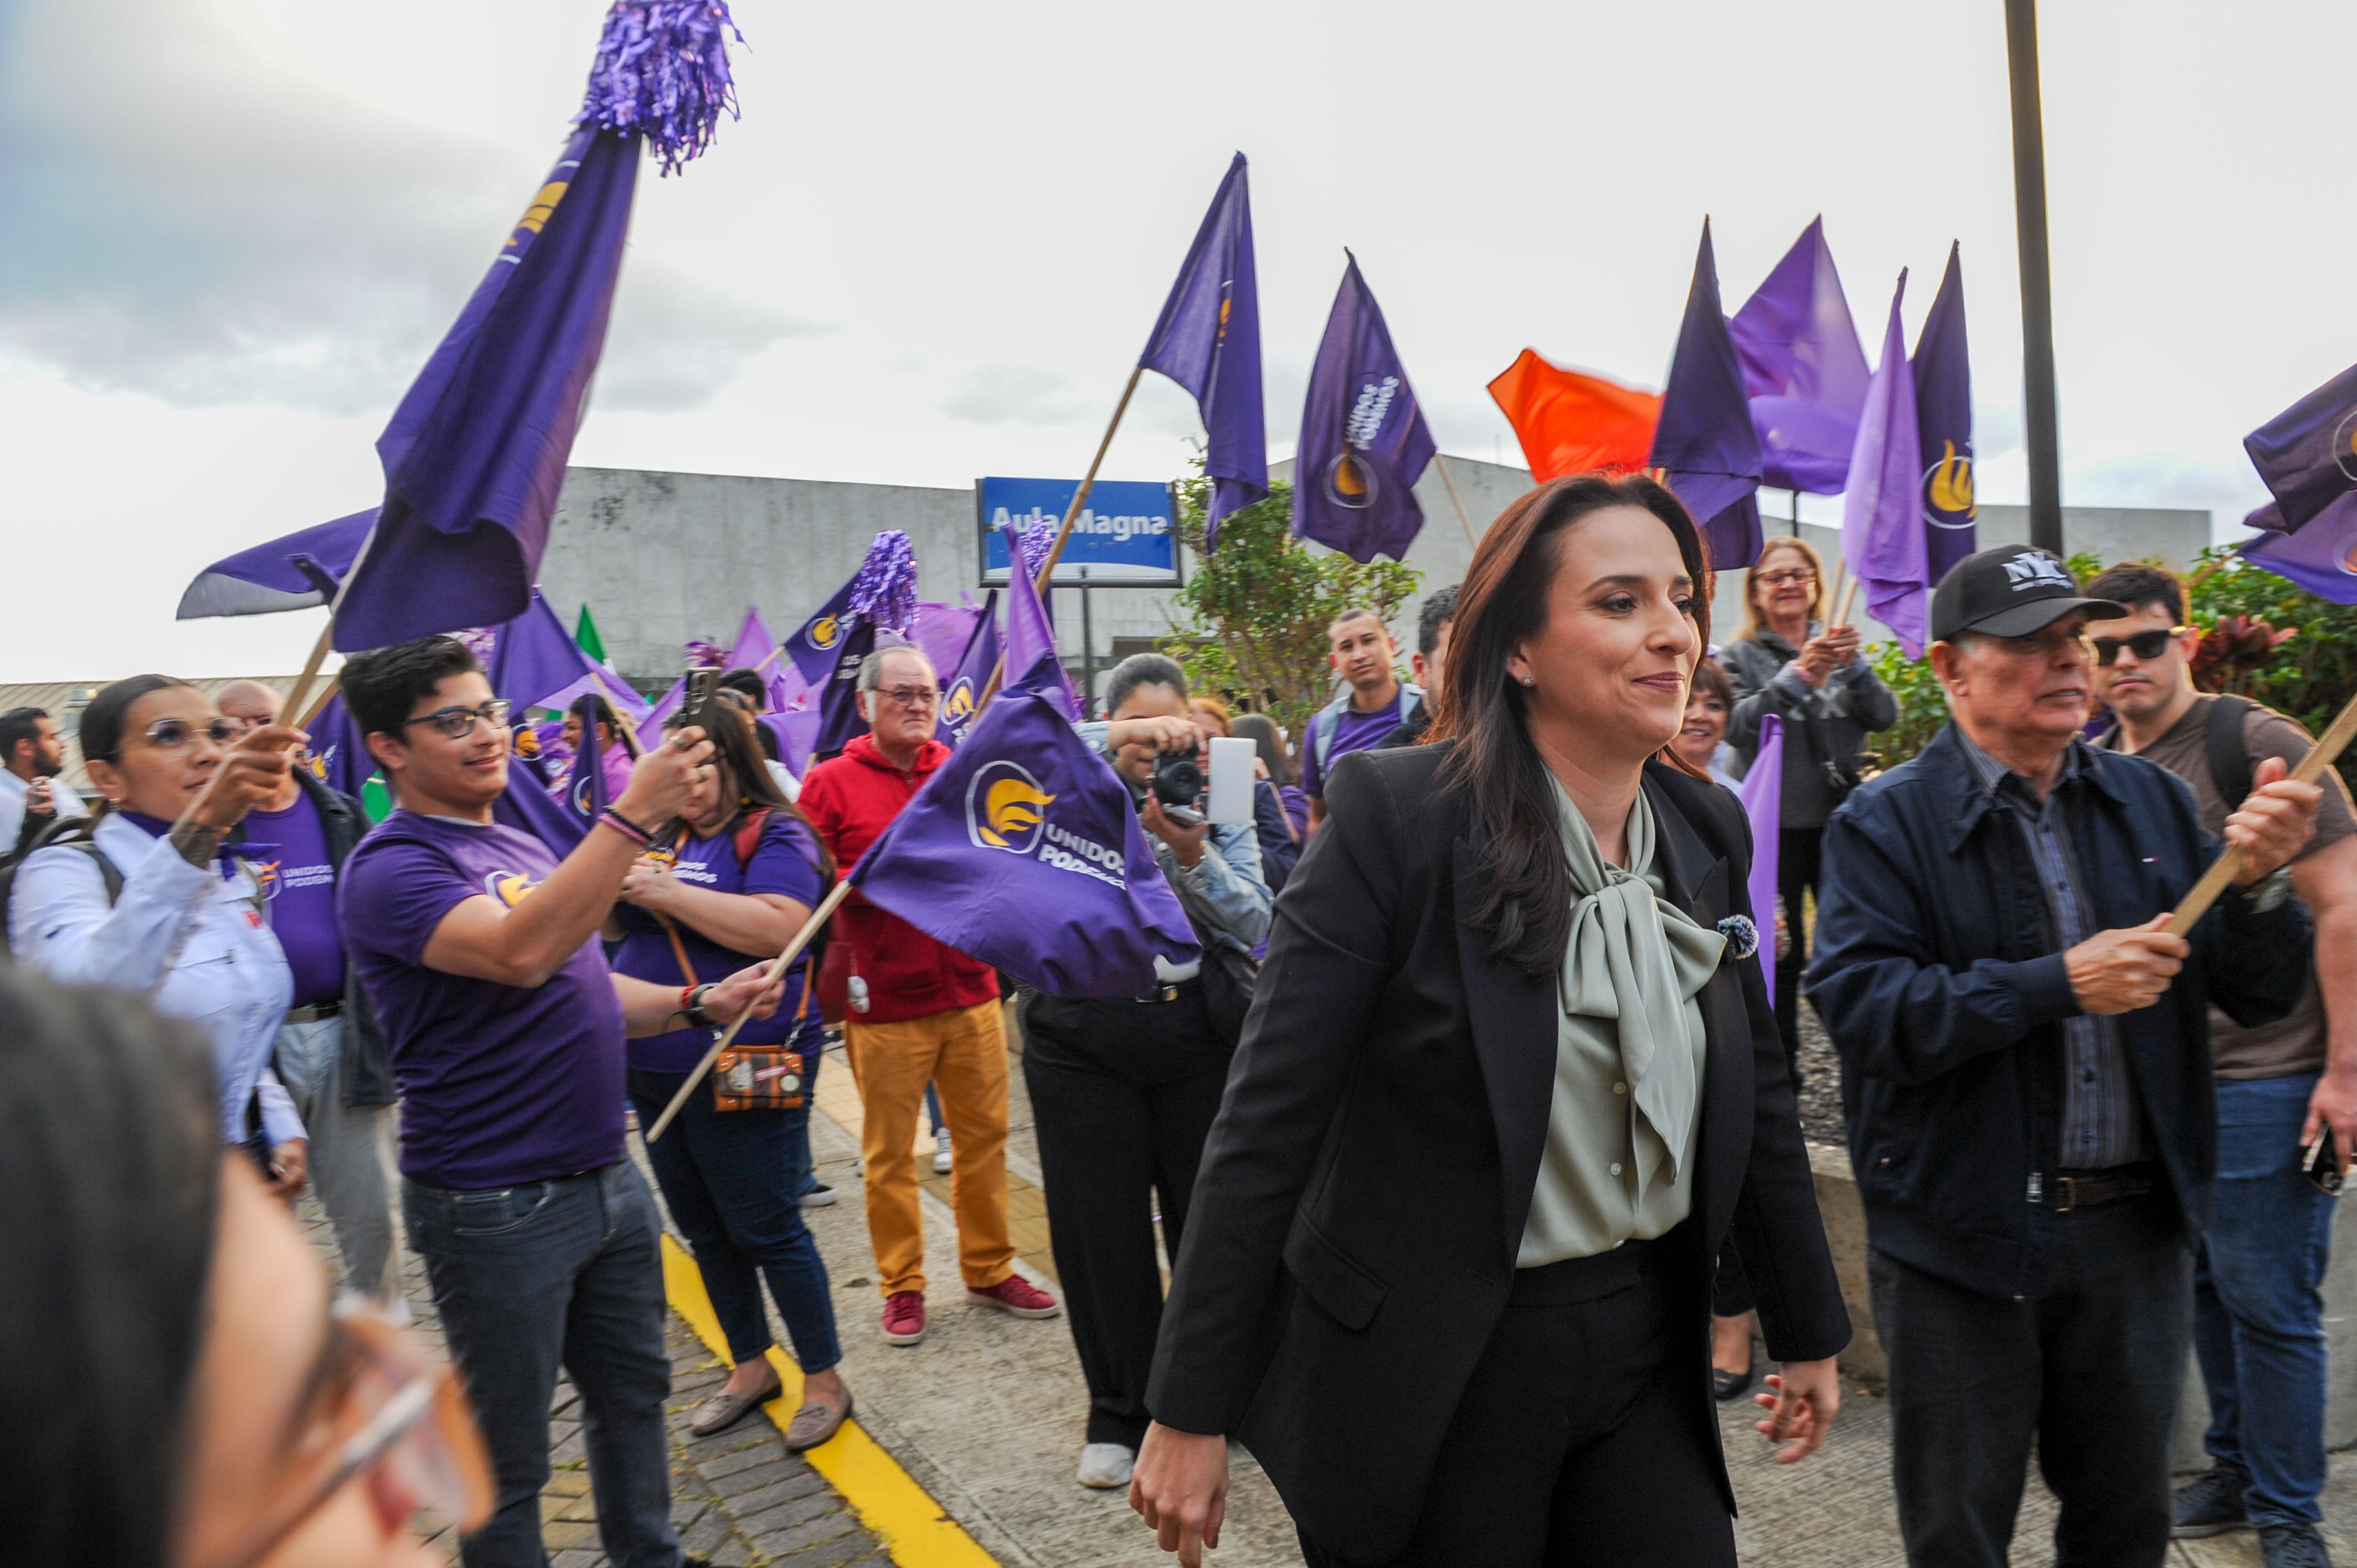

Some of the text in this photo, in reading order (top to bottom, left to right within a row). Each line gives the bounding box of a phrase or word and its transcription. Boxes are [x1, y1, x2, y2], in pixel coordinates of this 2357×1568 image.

[992, 507, 1168, 541] Aula Magna
[1038, 844, 1126, 890] PODEMO
